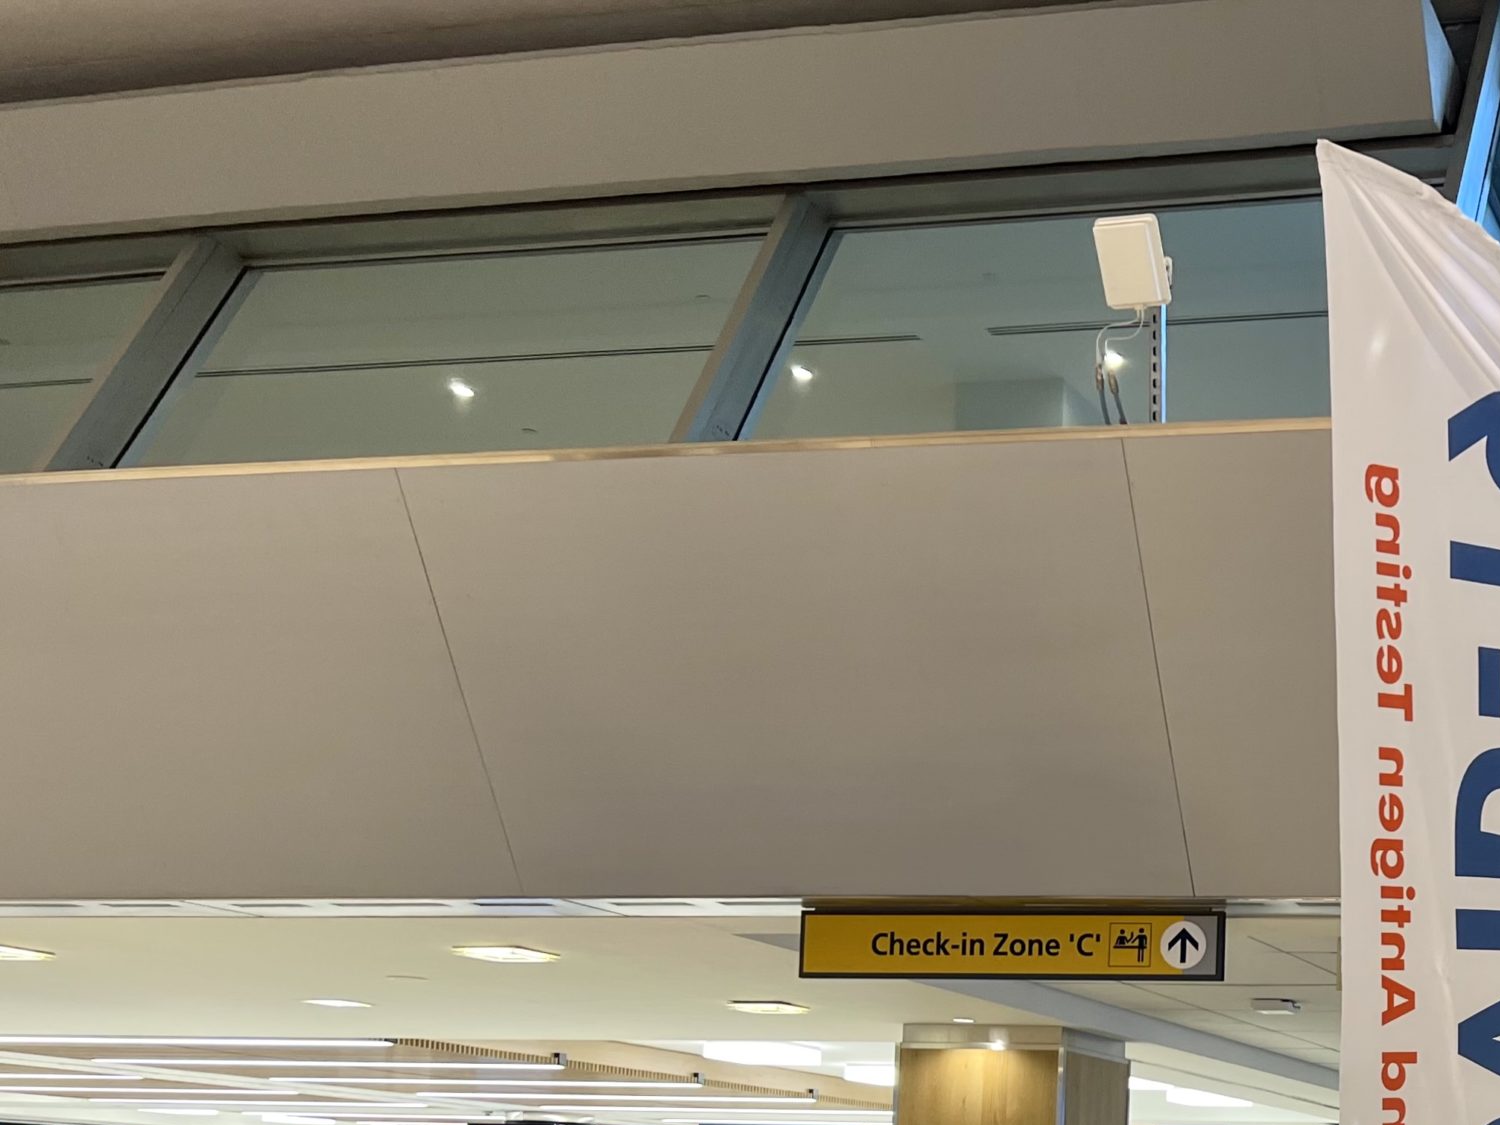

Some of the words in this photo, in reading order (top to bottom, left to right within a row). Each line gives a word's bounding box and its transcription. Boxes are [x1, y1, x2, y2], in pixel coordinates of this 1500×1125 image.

[871, 932, 984, 956] Check-in
[993, 933, 1060, 956] Zone
[1070, 933, 1101, 956] 'C'
